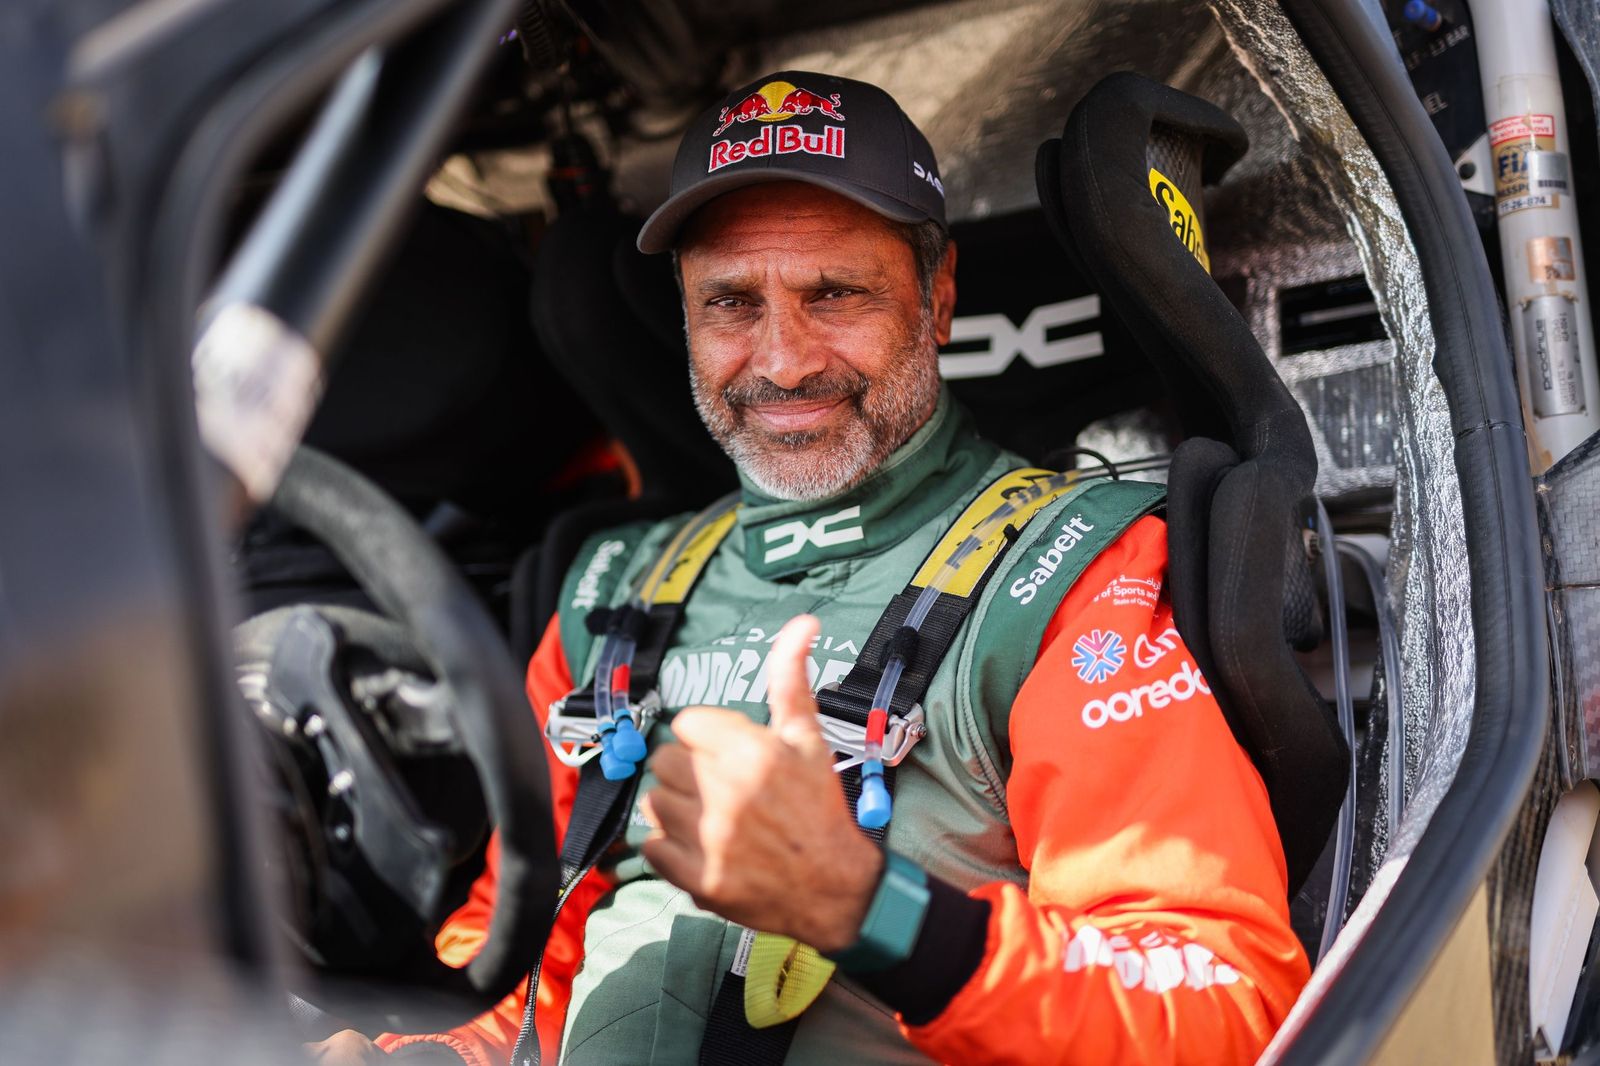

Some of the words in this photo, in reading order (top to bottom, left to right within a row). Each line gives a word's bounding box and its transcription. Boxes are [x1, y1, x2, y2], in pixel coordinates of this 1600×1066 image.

[707, 125, 773, 173] Red
[776, 124, 845, 159] Bull
[913, 161, 946, 199] DAC
[1155, 181, 1202, 259] Sab
[1009, 513, 1095, 605] Sabelt
[1113, 585, 1146, 597] Sports
[1081, 660, 1212, 729] ooredo
